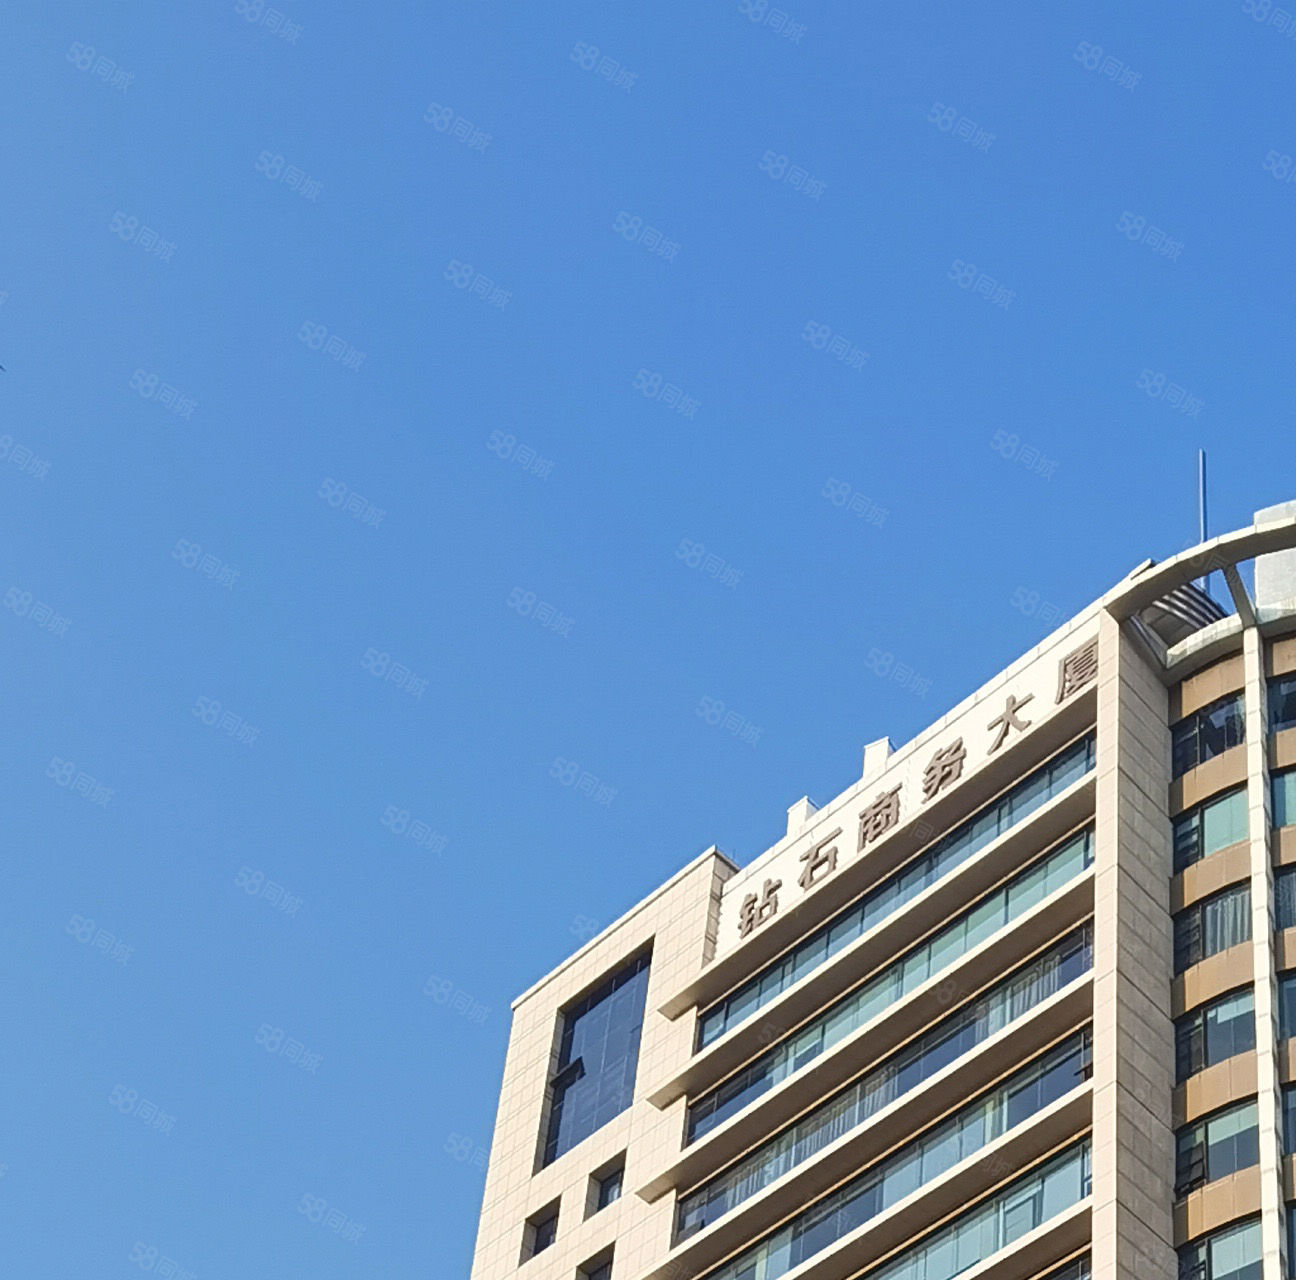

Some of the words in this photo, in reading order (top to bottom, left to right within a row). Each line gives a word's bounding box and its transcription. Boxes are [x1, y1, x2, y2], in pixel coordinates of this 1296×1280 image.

[737, 641, 1099, 939] 钻石商务大厦
